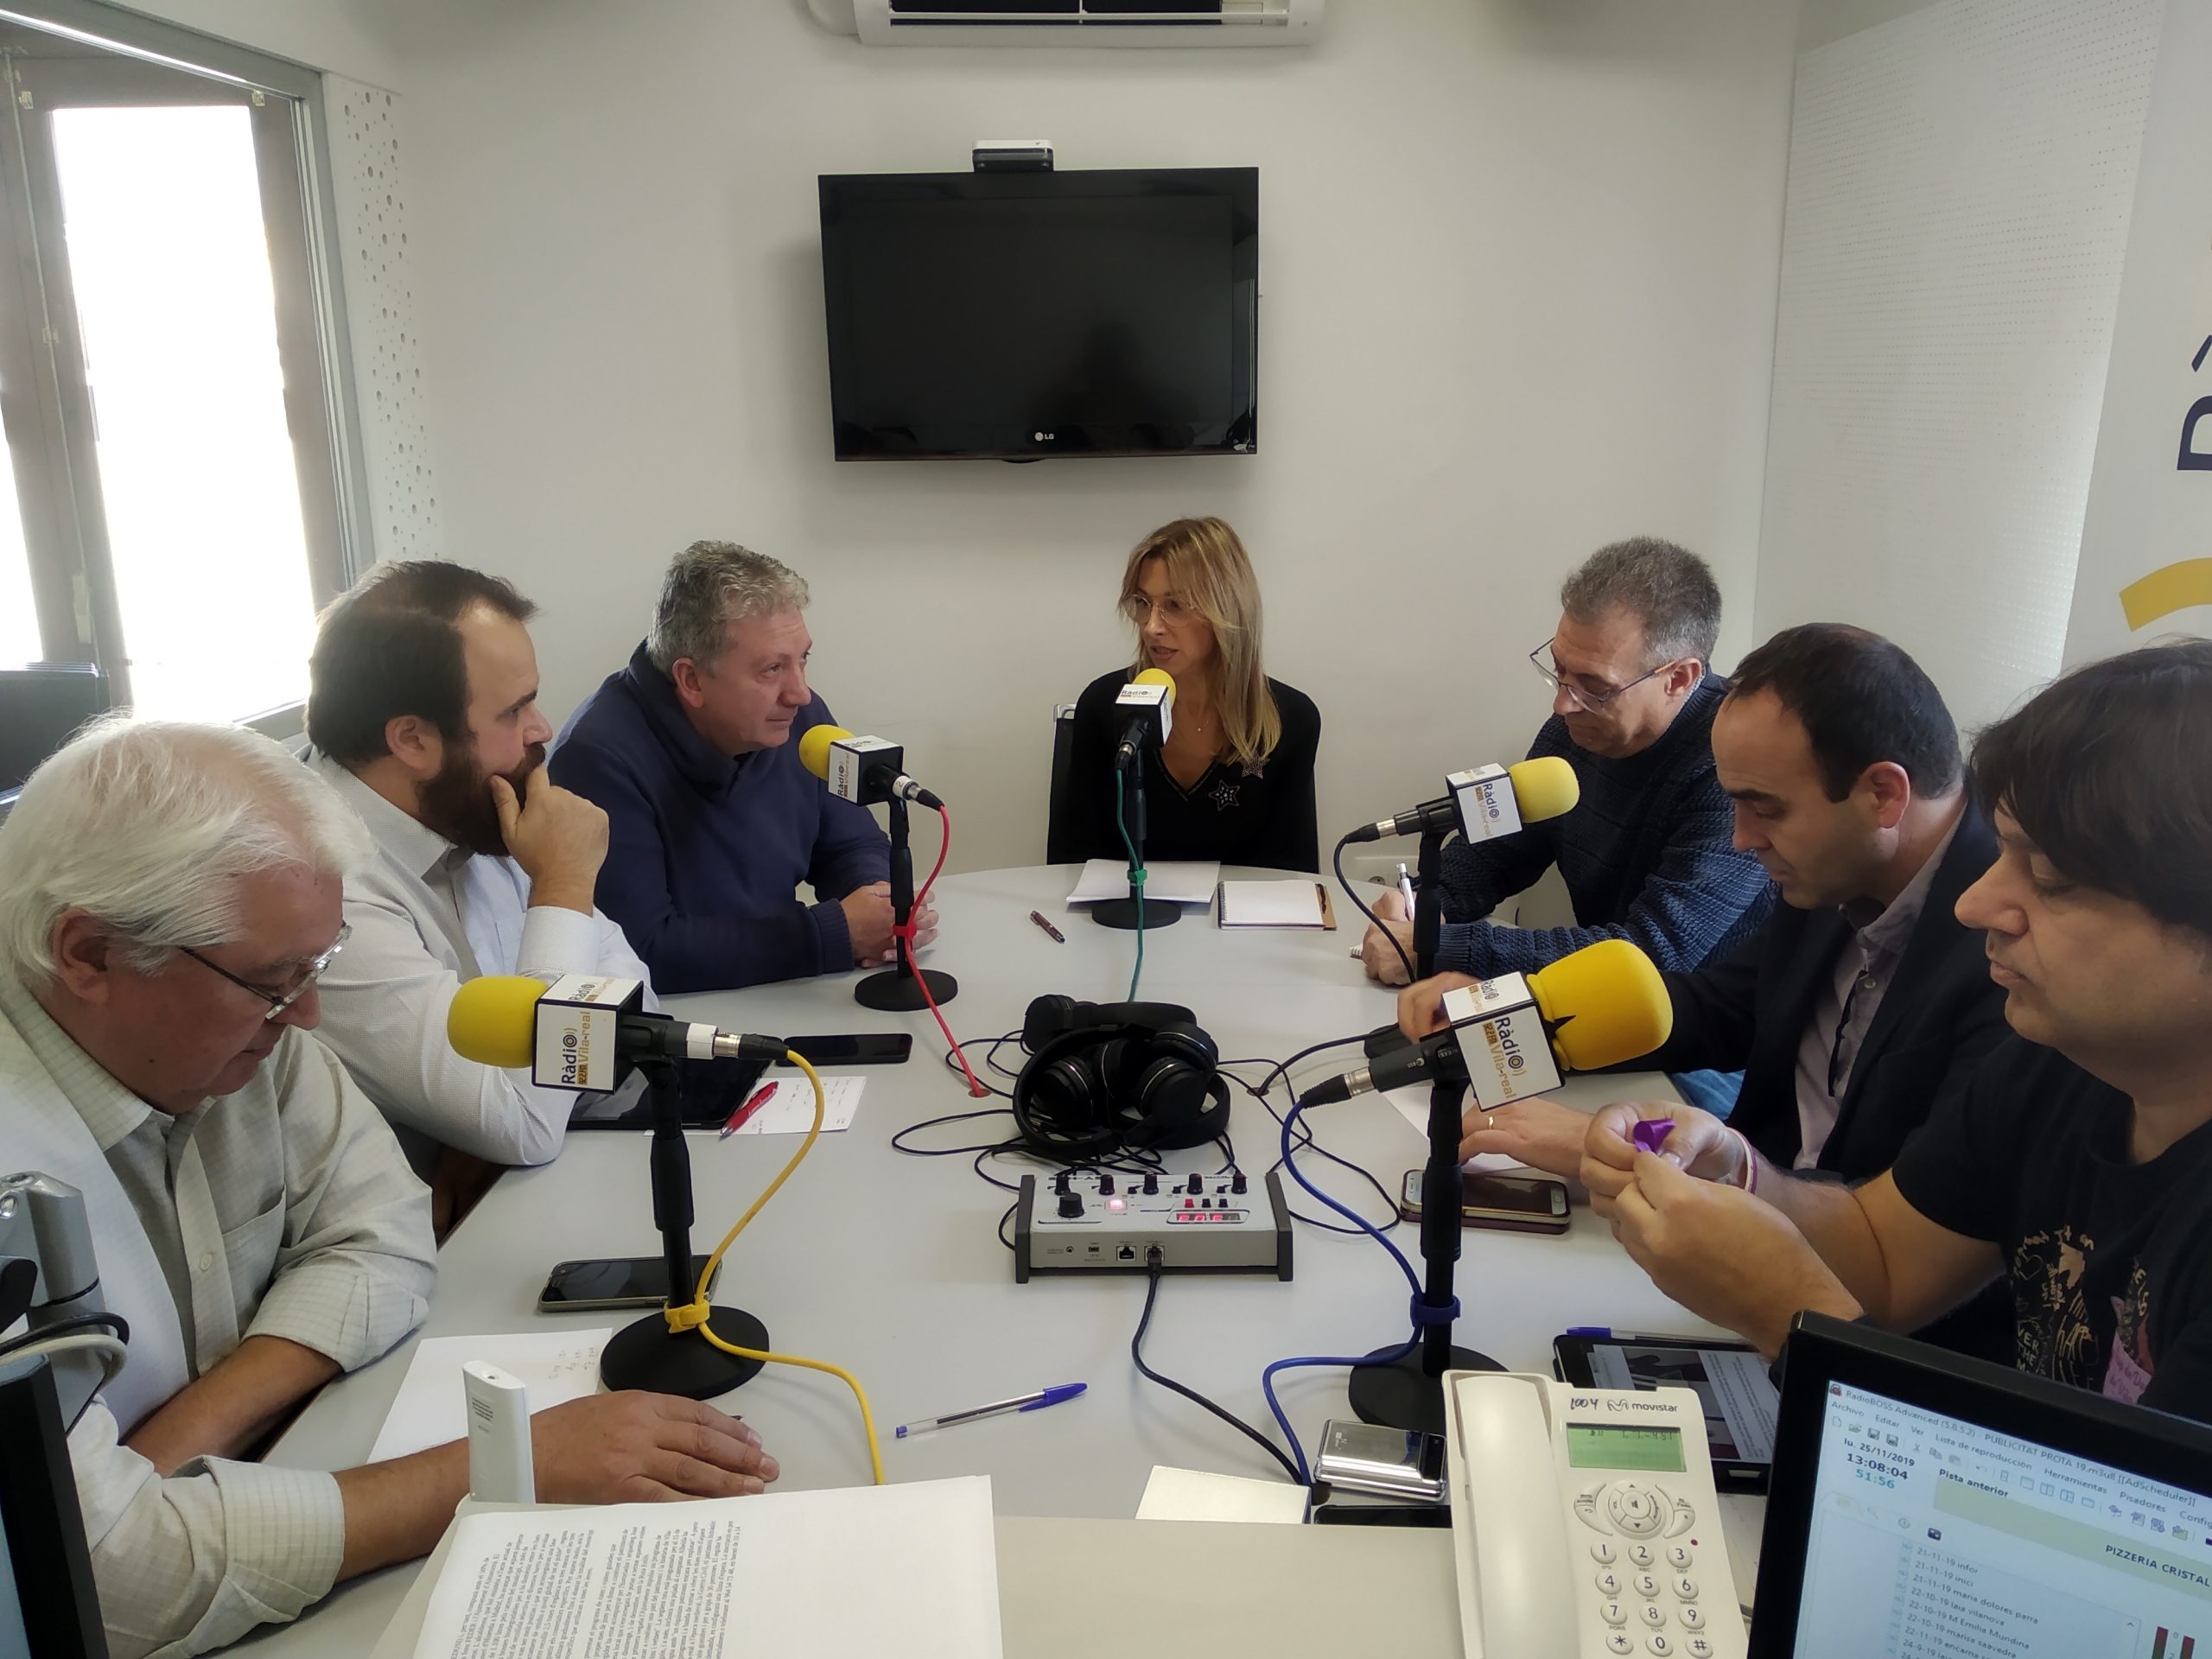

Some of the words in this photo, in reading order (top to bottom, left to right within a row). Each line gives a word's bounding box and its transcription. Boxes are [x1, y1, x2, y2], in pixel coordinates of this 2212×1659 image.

[1483, 783, 1500, 818] Ràdio
[579, 1011, 591, 1063] Vila-real
[1495, 1016, 1524, 1070] Ràdio
[562, 1033, 577, 1084] Ràdio
[1490, 1045, 1516, 1098] Vila-real
[1570, 1398, 1599, 1410] 1004
[1631, 1402, 1678, 1412] movistar
[1832, 1401, 1865, 1417] Archivo
[1875, 1414, 1899, 1428] Editar
[1911, 1426, 1923, 1436] Ver
[1847, 1390, 1894, 1411] RadioBOSS
[1895, 1407, 1939, 1426] Advanced
[1986, 1433, 2037, 1457] PUBLICITAT
[2041, 1451, 2072, 1467] PROTA
[2076, 1461, 2115, 1481] 19.m3u8
[1844, 1438, 1858, 1448] lu.
[1859, 1442, 1915, 1467] 25/11/2019
[1936, 1433, 1955, 1446] Lista
[1958, 1441, 1969, 1451] de
[1972, 1444, 2032, 1471] reproducción
[1847, 1452, 1908, 1480] 13:08:04
[1856, 1469, 1895, 1490] 51:56
[1939, 1469, 1963, 1484] Pista
[1967, 1478, 2009, 1498] anterior
[2044, 1467, 2107, 1494] Herramientas
[2120, 1491, 2166, 1512] Pisadores
[1602, 1544, 1607, 1555] 1
[1637, 1546, 1648, 1558] 2
[1675, 1548, 1685, 1560] 3
[1917, 1548, 1955, 1566] 21-11-19
[2106, 1544, 2157, 1569] PIZZERIA
[2162, 1564, 2210, 1587] CRISTAL
[1605, 1574, 1614, 1587] 4
[1644, 1577, 1653, 1588] 5
[1681, 1579, 1692, 1592] 6
[1915, 1560, 1953, 1580] 21-11-19
[591, 1607, 601, 1630] programa
[606, 1552, 615, 1569] guiades
[1913, 1574, 1951, 1592] 21-11-19
[1980, 1599, 2013, 1616] dolores
[2015, 1611, 2039, 1624] parra
[611, 1597, 622, 1624] acompanyat
[1609, 1605, 1618, 1616] 7
[1649, 1607, 1658, 1619] 8
[1688, 1609, 1697, 1621] 9
[1911, 1587, 1949, 1606] 22-10-19
[1968, 1609, 2005, 1626] vilanova
[635, 1618, 645, 1634] vegada
[1904, 1626, 1942, 1645] 22-11-19
[1907, 1613, 1944, 1632] 22-10-19
[1978, 1640, 2017, 1659] saavedra
[1909, 1600, 1946, 1619] 22-10-19
[1949, 1614, 1958, 1624] M
[1960, 1618, 1986, 1634] Emilia
[1989, 1629, 2030, 1649] Mundina
[632, 1636, 641, 1655] primera
[1656, 1637, 1666, 1649] 0
